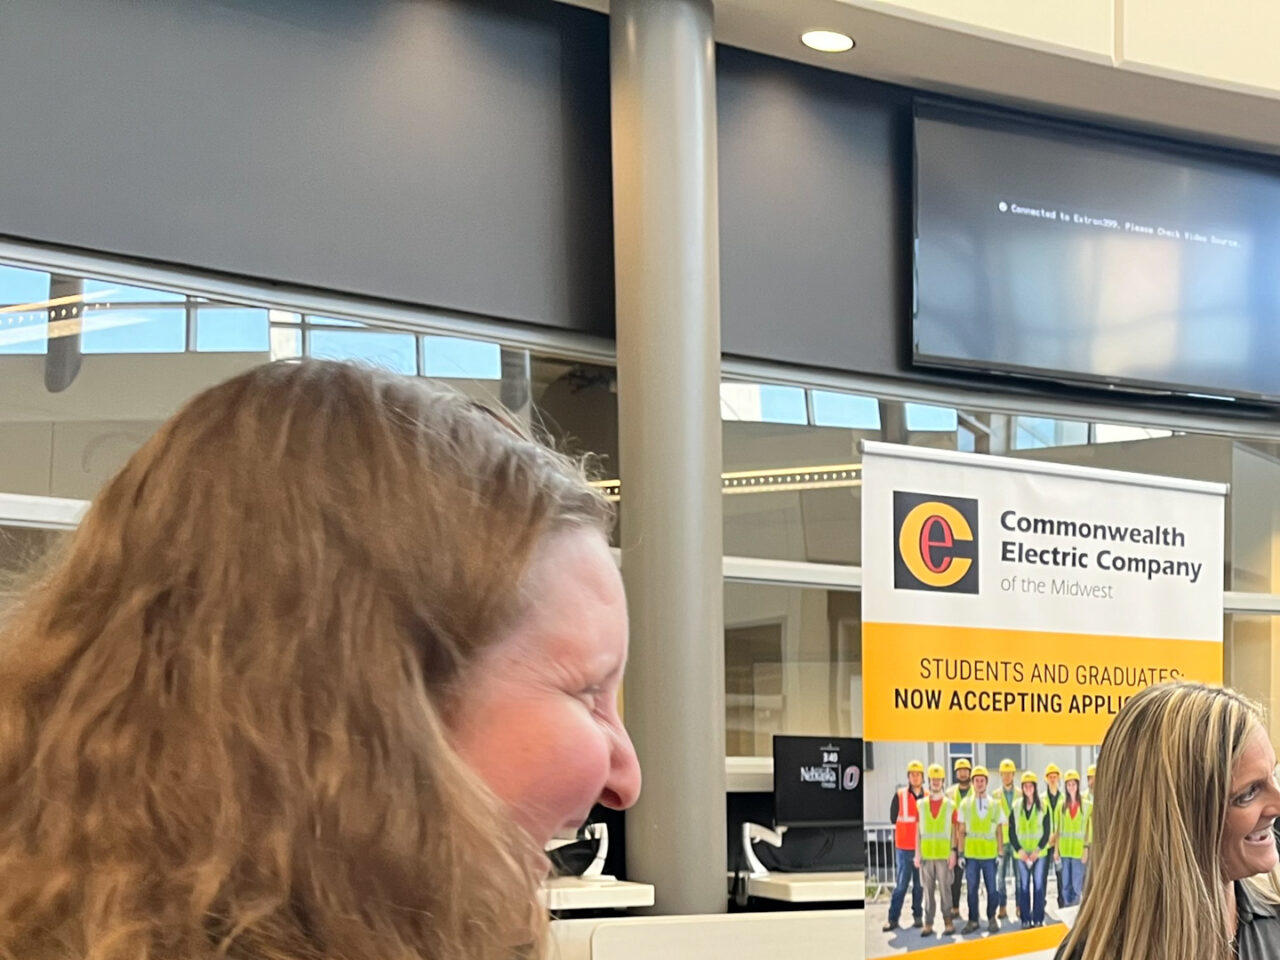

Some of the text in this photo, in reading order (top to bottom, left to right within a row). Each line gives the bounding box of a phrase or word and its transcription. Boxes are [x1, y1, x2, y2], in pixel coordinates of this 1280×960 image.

[1011, 203, 1056, 220] Connected
[1060, 211, 1070, 222] to
[1125, 221, 1154, 235] Please
[1157, 226, 1180, 239] Check
[1000, 510, 1186, 548] Commonwealth
[1001, 541, 1203, 583] Electric Company
[1001, 575, 1114, 599] of the Midwest
[919, 657, 1024, 683] STUDENTS
[1030, 663, 1069, 685] AND
[894, 688, 942, 711] NOW
[949, 690, 1063, 714] ACCEPTING
